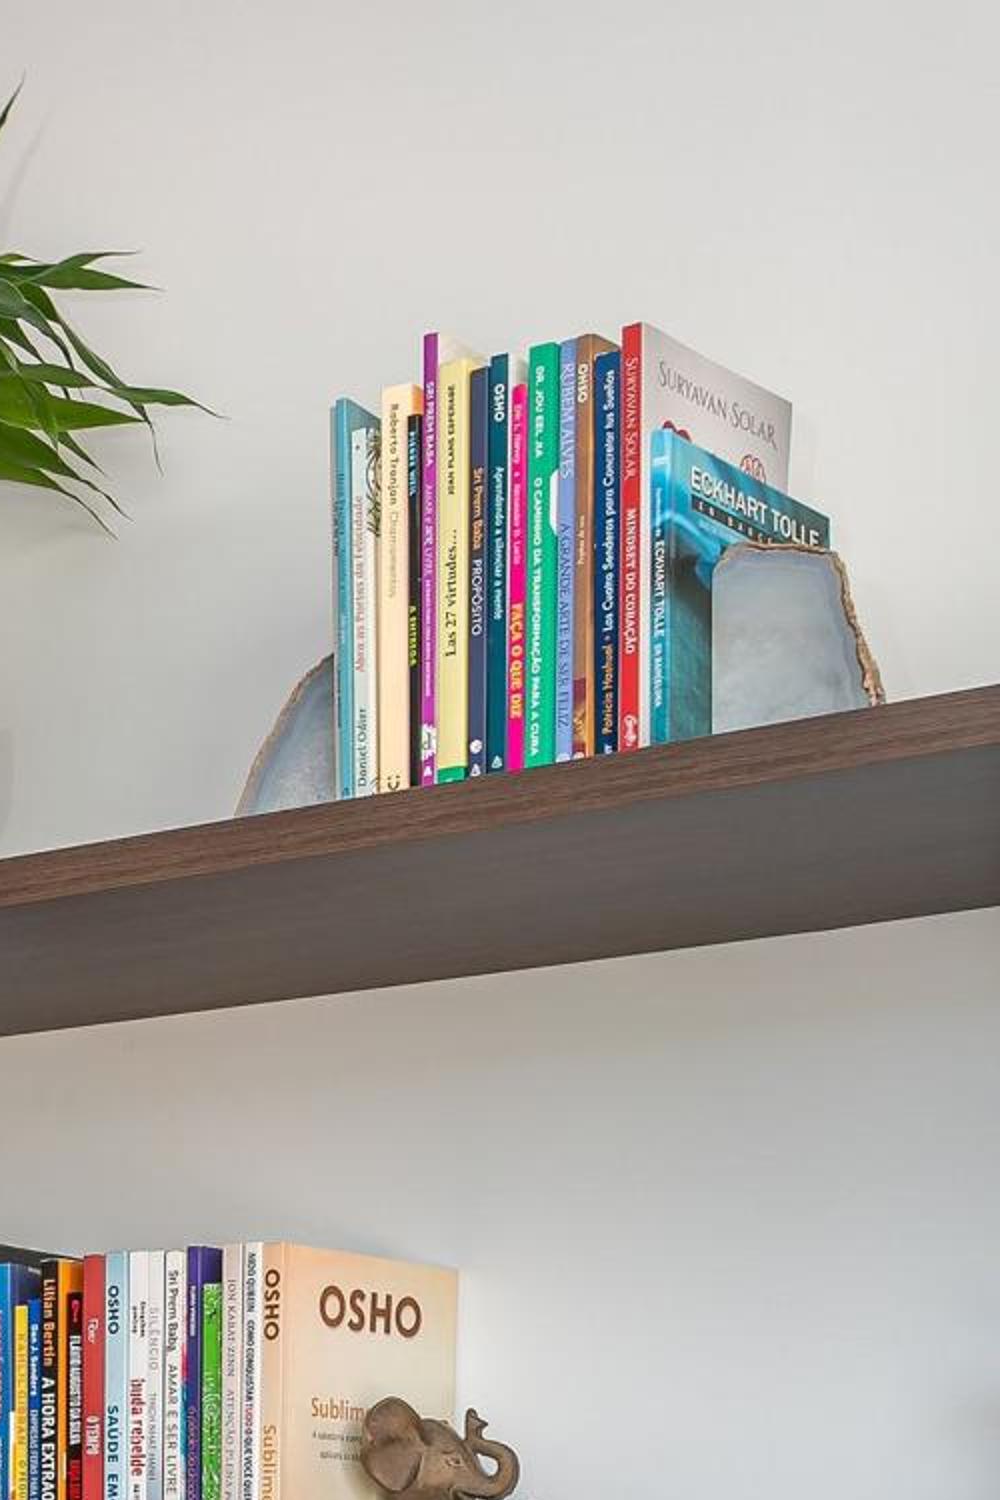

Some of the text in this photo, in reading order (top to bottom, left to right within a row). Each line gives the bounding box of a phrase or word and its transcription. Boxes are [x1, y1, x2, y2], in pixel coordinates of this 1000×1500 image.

[535, 366, 544, 386] DR.
[577, 363, 588, 403] OSHO
[602, 369, 614, 411] Sueños
[494, 383, 505, 422] OSHO
[535, 390, 544, 413] JOU
[624, 357, 637, 481] SURYAVAN SOLAR
[659, 360, 778, 450] SURYAVAN SOLAR
[533, 490, 543, 546] CAMINHO
[604, 488, 616, 517] para
[690, 465, 768, 525] ECKHART
[771, 508, 820, 545] TOLLE
[473, 520, 483, 550] Baba
[602, 518, 614, 571] Senderos
[533, 548, 542, 566] DA
[559, 537, 571, 599] GRANDE
[655, 540, 665, 597] ECKHART
[472, 559, 484, 637] PROPÓSITO
[602, 571, 614, 611] Cuatro
[623, 508, 637, 655] MINDSET DO CORAÇÃO
[445, 611, 457, 628] 27
[530, 567, 542, 675] TRANSFORMAÇÃO
[602, 613, 614, 632] Los
[654, 601, 665, 638] TOLLE
[445, 631, 457, 657] Las
[510, 602, 523, 719] FAÇA O QUE DIZ
[168, 1270, 179, 1287] Sri
[43, 1279, 56, 1367] Lilian Bertin
[108, 1285, 120, 1335] OSHO
[168, 1288, 179, 1321] Prem
[263, 1268, 281, 1341] OSHO
[319, 1284, 423, 1339] OSHO
[246, 1320, 255, 1346] COMO
[41, 1376, 55, 1389] A
[167, 1364, 178, 1405] AMAR
[41, 1393, 55, 1440] HORA
[311, 1397, 367, 1423] Sublim
[107, 1405, 122, 1463] SAÚDE
[167, 1423, 178, 1449] SER
[166, 1454, 178, 1496] LIVRE
